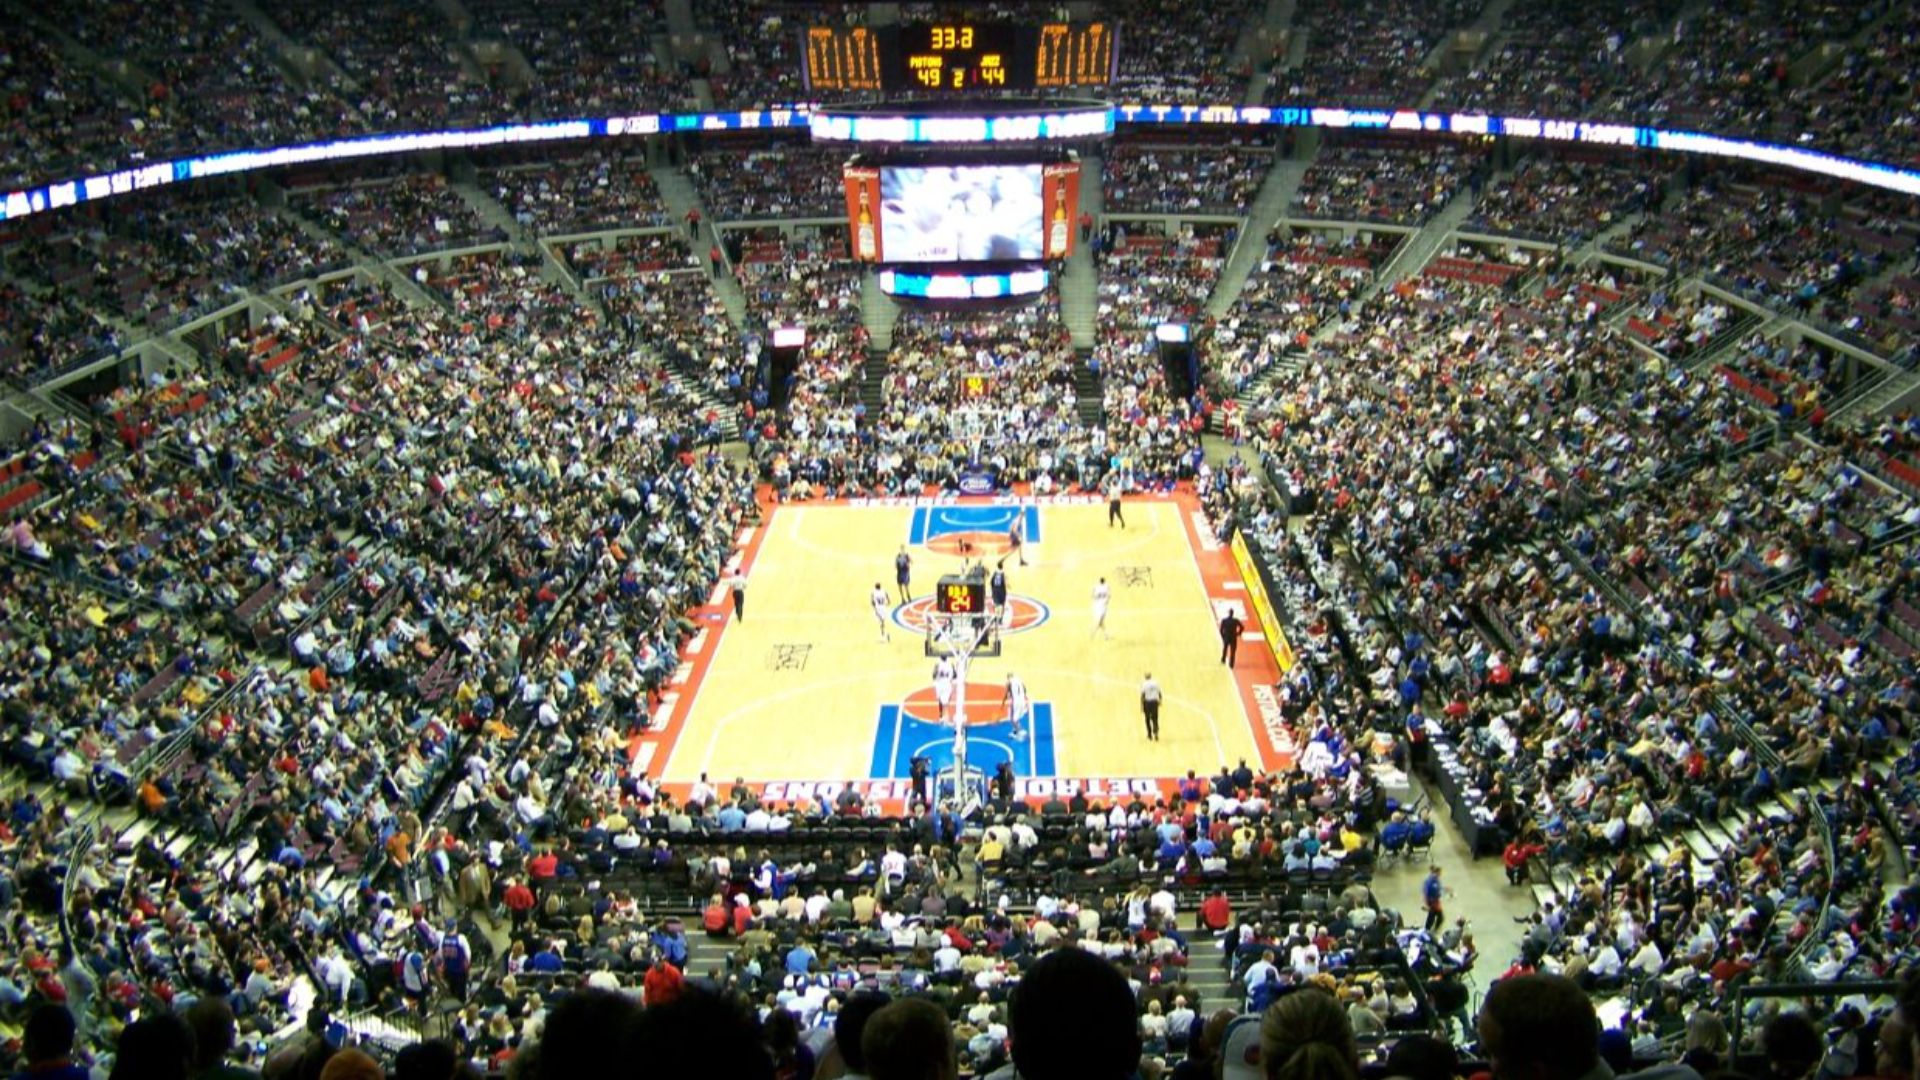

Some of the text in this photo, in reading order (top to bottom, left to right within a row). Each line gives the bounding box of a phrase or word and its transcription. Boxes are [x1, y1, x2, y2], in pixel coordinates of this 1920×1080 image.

[931, 27, 974, 49] 33.2
[910, 56, 942, 68] PISTONS
[918, 68, 941, 87] 49
[953, 70, 964, 88] 2
[982, 68, 1005, 85] 44
[950, 596, 971, 612] 24
[1012, 778, 1158, 797] DETROI
